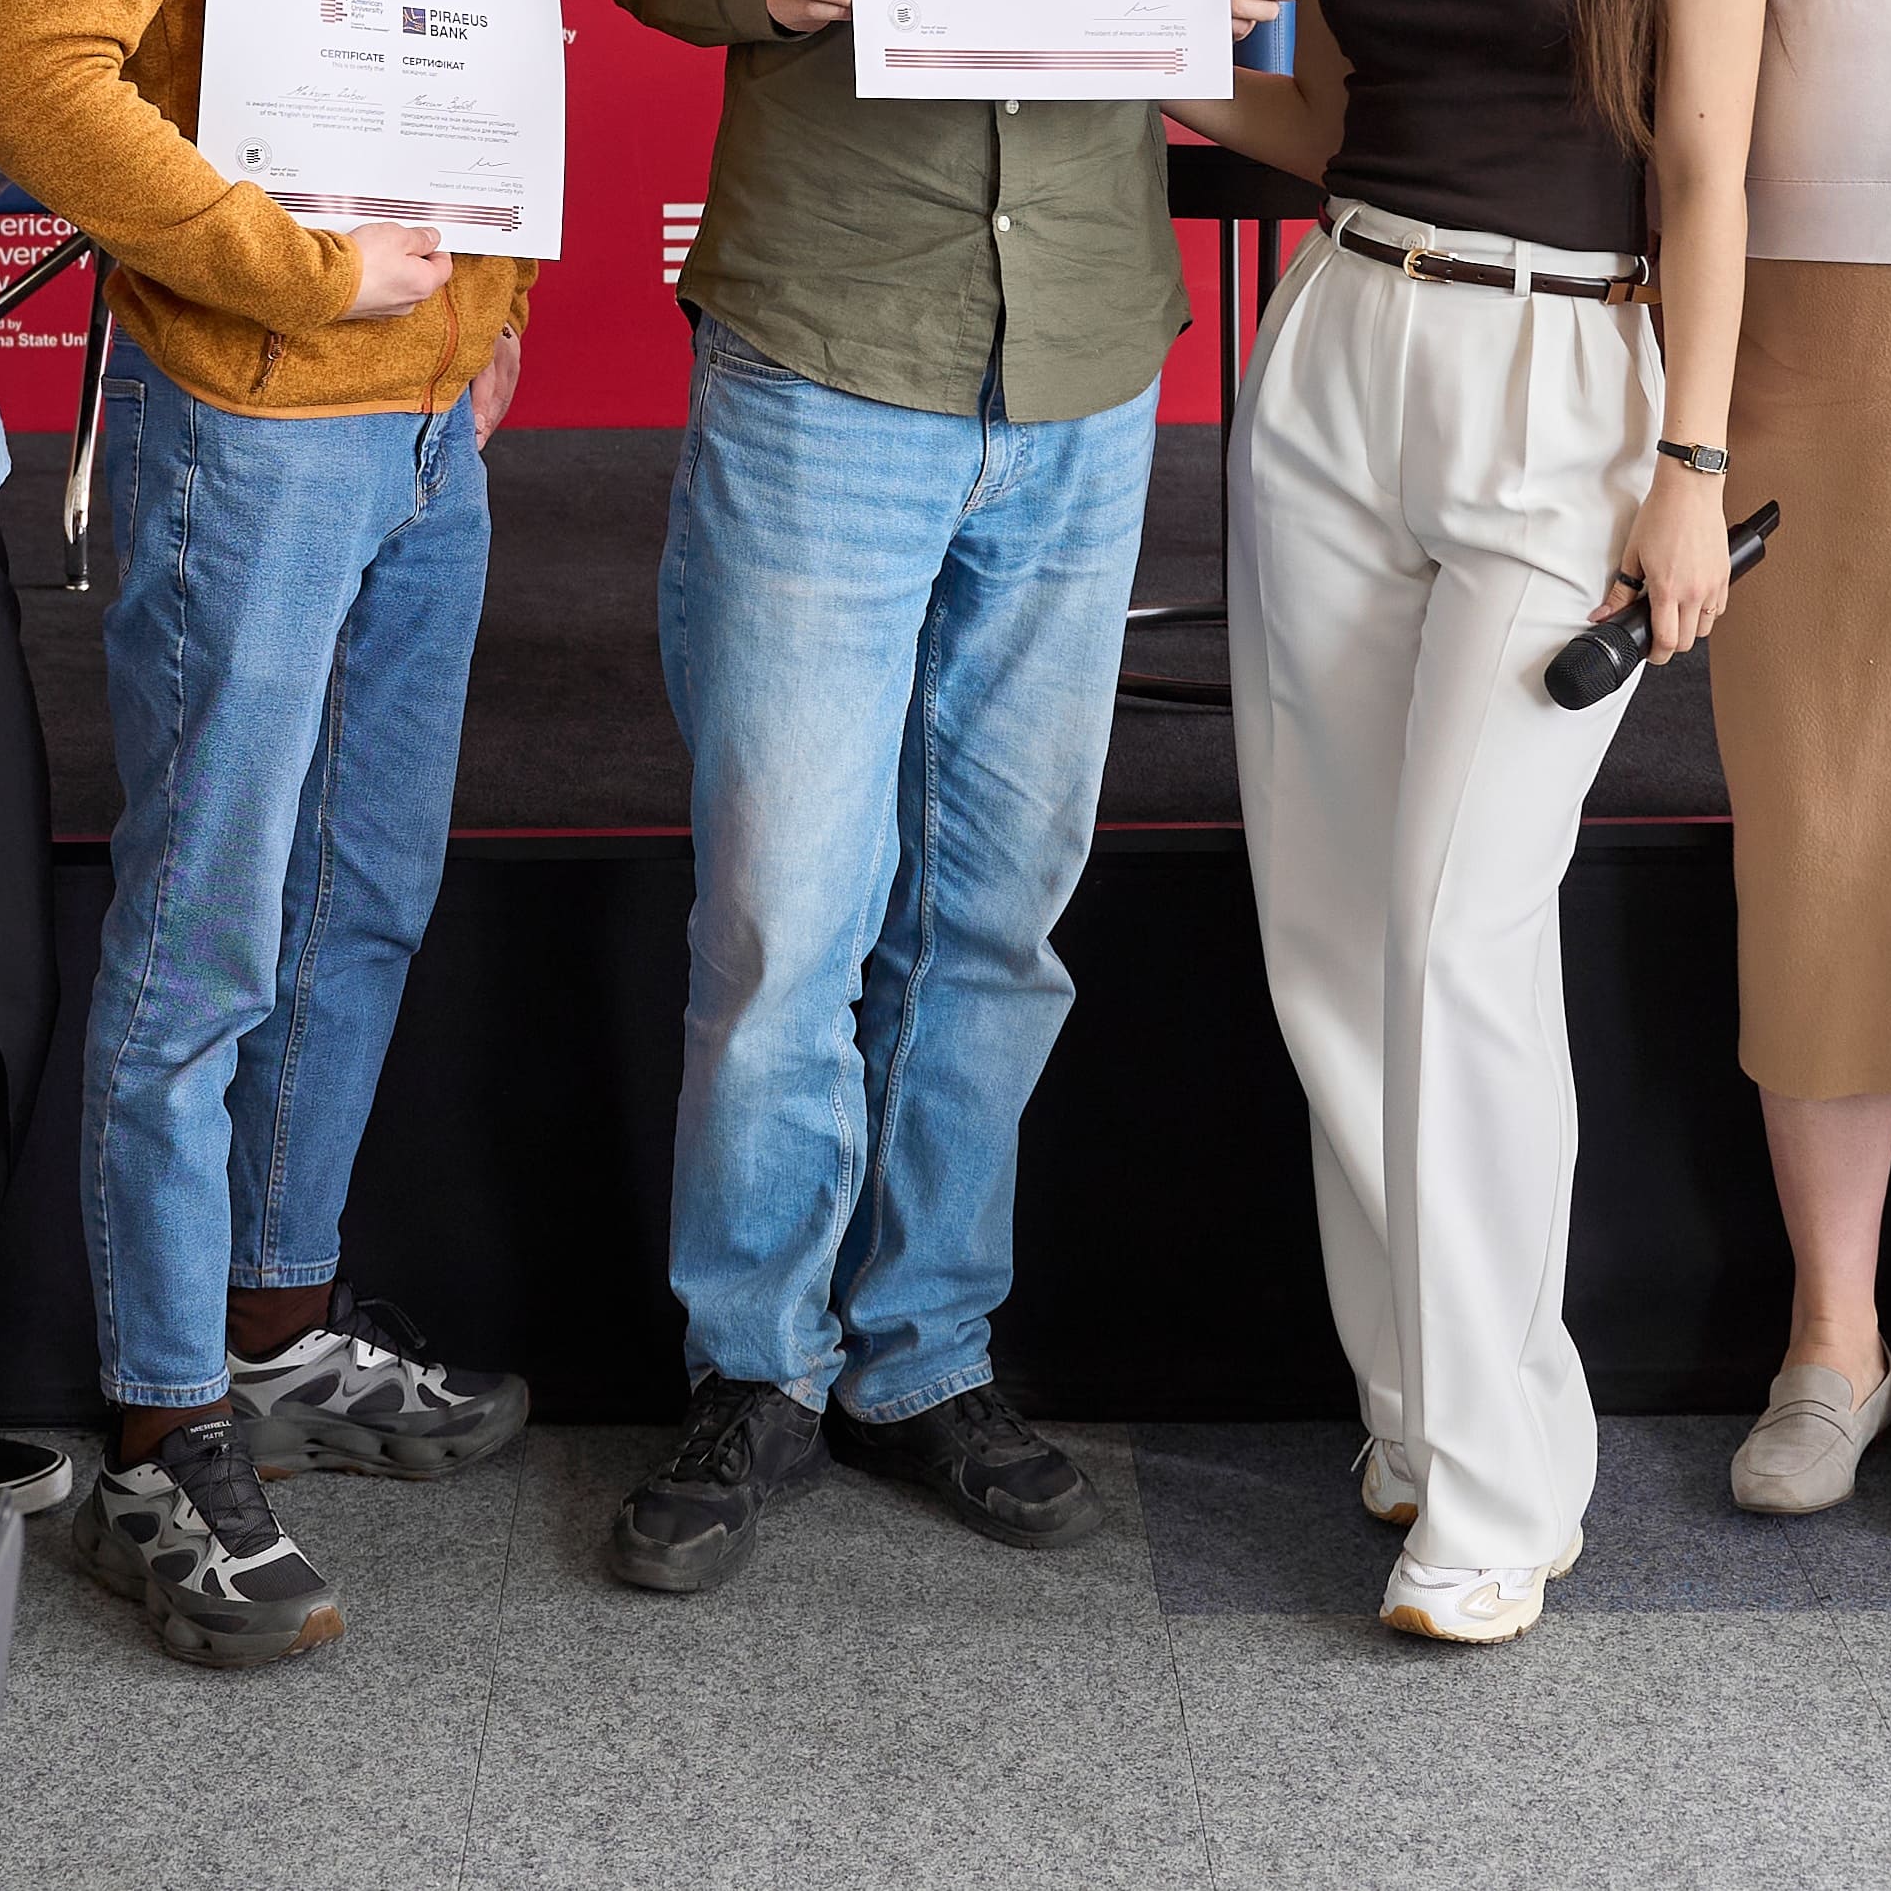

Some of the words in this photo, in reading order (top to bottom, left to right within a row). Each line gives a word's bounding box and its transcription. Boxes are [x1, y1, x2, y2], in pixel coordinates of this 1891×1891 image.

[430, 10, 488, 27] PIRAEUS
[430, 25, 468, 40] BANK
[320, 49, 385, 63] CERTIFICATE
[402, 56, 465, 70] СЕРТИФІКАТ
[19, 333, 57, 347] State
[190, 1420, 232, 1434] MERRELL
